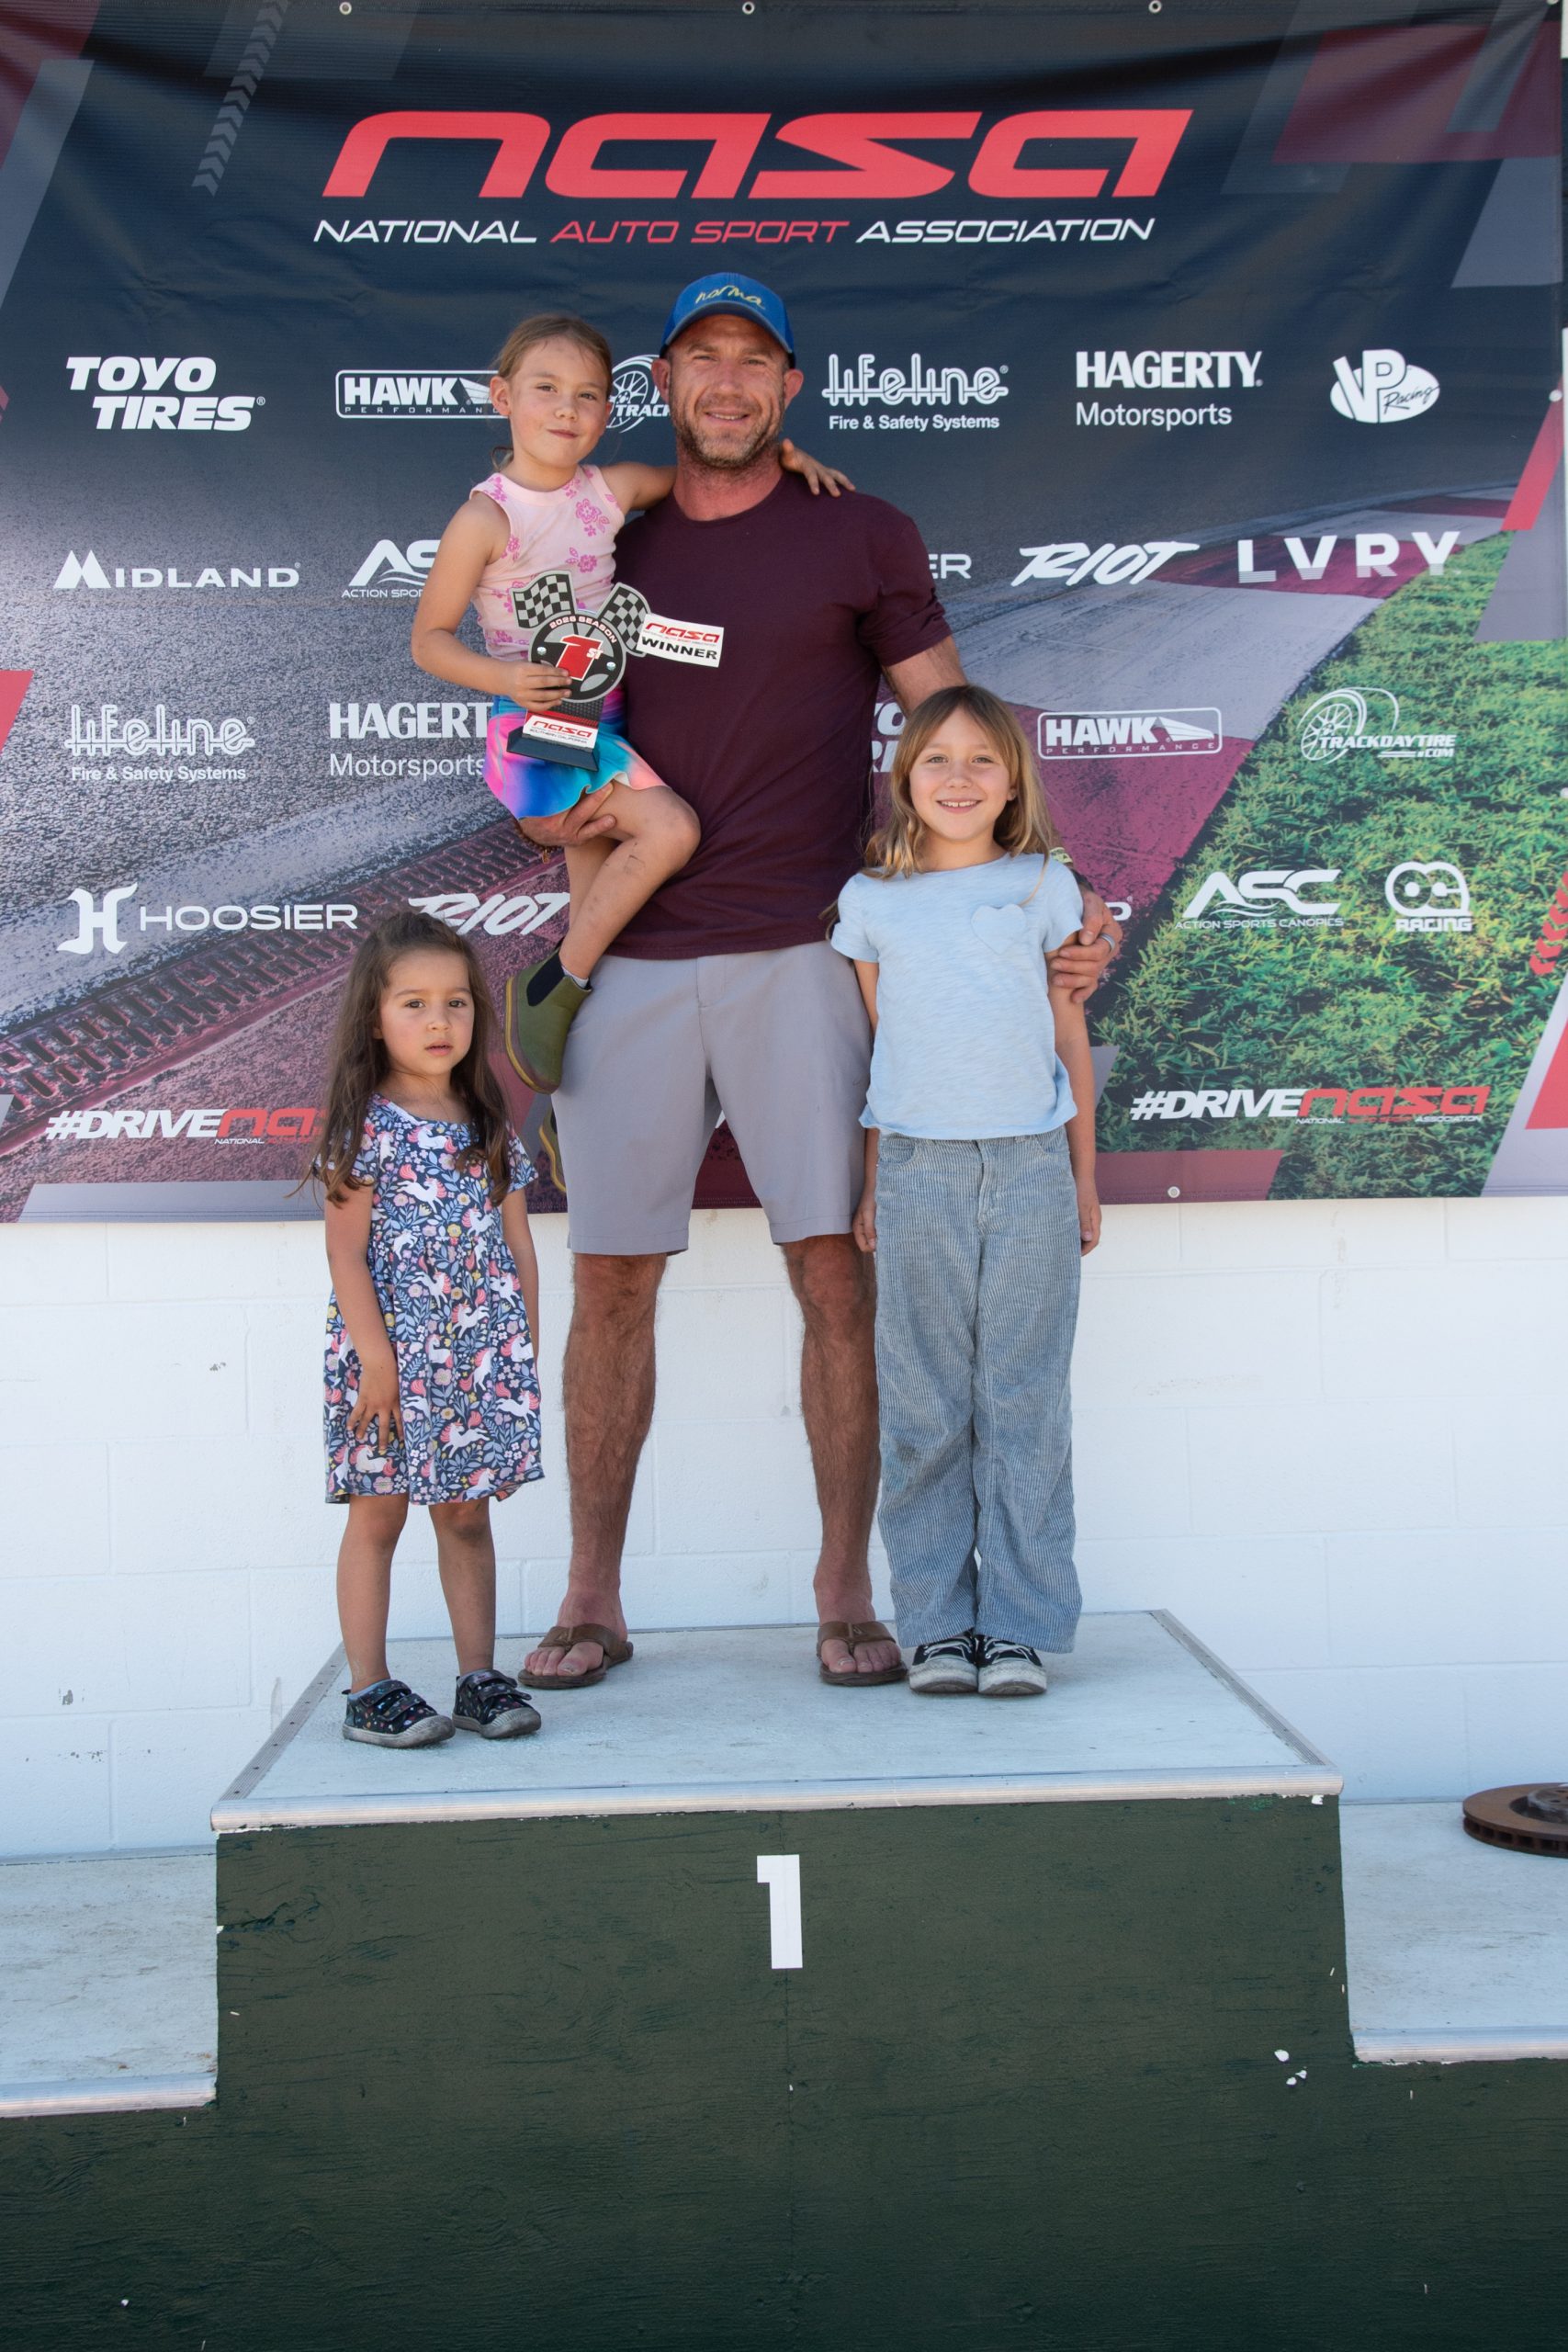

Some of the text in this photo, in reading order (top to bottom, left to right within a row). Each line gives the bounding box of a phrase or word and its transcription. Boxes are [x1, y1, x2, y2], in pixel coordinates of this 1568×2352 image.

[313, 218, 1156, 243] NATIONAL AUTO SPORT ASSOCIATION
[66, 356, 217, 391] TOYO
[1076, 351, 1262, 388] HAGERTY
[344, 377, 459, 405] HAWK
[1332, 349, 1406, 424] VP
[1383, 386, 1440, 415] Racing
[93, 396, 255, 432] TIRES
[829, 414, 1000, 433] Fire & Safety Systems
[1076, 402, 1233, 431] Motorsports
[53, 549, 299, 588] MIDLAND
[1010, 540, 1201, 587] RIOT
[1237, 532, 1461, 583] LVRY
[341, 589, 388, 598] ACTION
[549, 616, 617, 643] 2026 SEASON
[642, 636, 718, 660] WINNER
[329, 702, 493, 739] HAGERT
[1045, 717, 1158, 746] HAWK
[1046, 742, 1214, 754] PERFORMANCE
[1319, 734, 1457, 749] TRACKDAYTIRE
[72, 766, 246, 784] Fire & Safety Systems
[1181, 869, 1341, 918] ASC
[140, 905, 358, 932] HOOSIER
[1175, 920, 1221, 930] ACTION
[1224, 919, 1276, 929] SPORTS
[1395, 919, 1472, 932] RACING
[756, 1854, 804, 1970] 1
